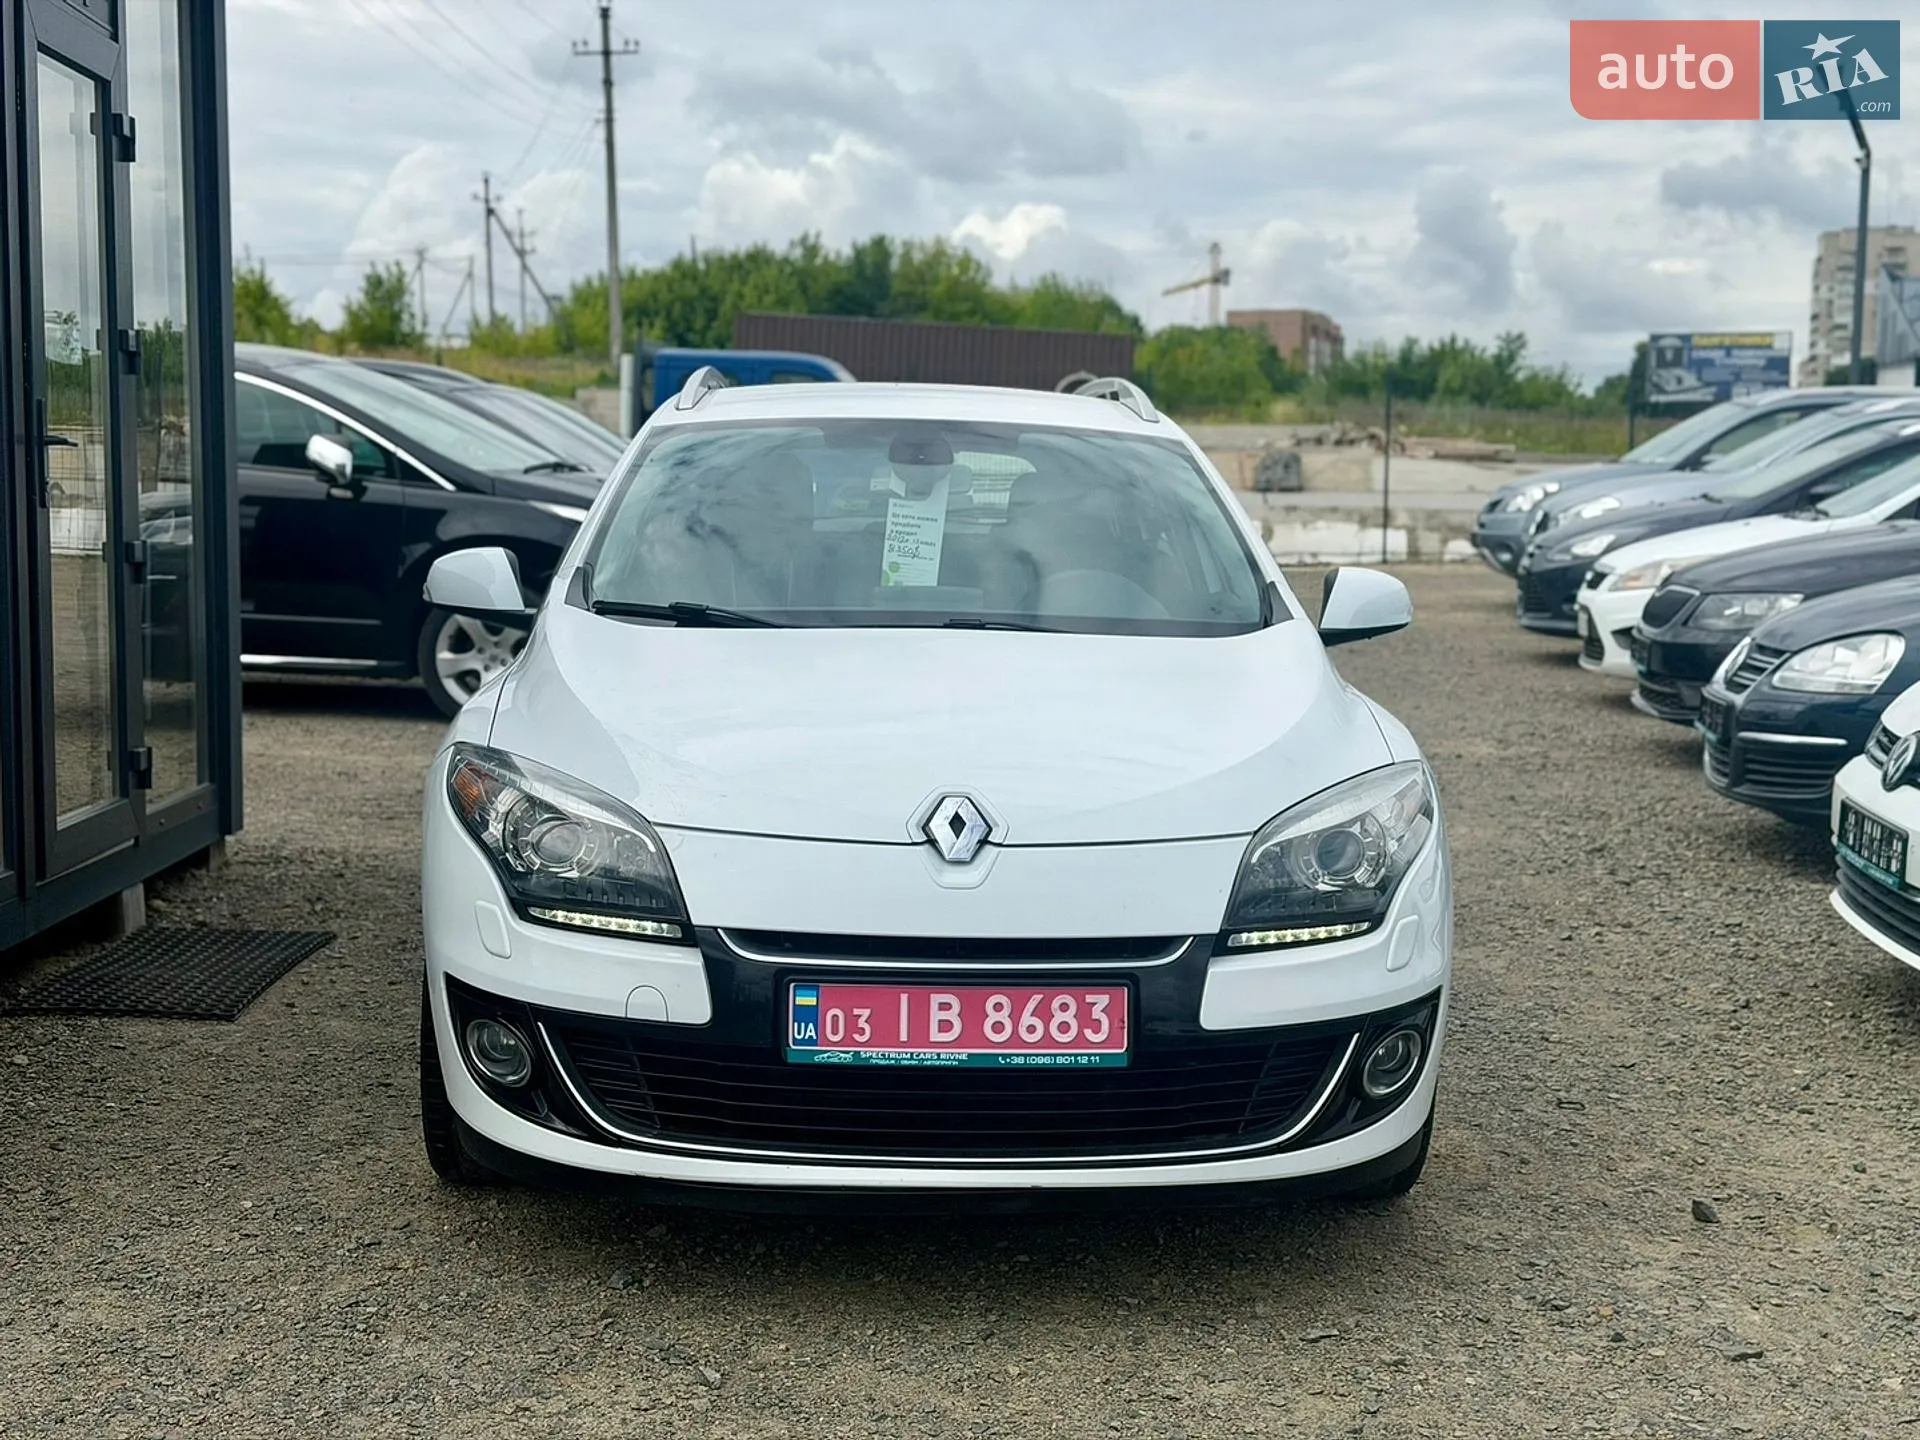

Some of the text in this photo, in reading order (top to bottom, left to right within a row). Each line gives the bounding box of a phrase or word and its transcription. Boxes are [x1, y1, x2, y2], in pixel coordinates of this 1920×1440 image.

[825, 1008, 872, 1043] 03
[982, 993, 1111, 1043] 8683
[794, 1022, 817, 1040] UA
[860, 1051, 911, 1059] SPECTRUM
[913, 1052, 938, 1060] CARS
[1056, 1056, 1075, 1064] 801
[1077, 1056, 1089, 1064] 12
[1090, 1056, 1100, 1064] 11
